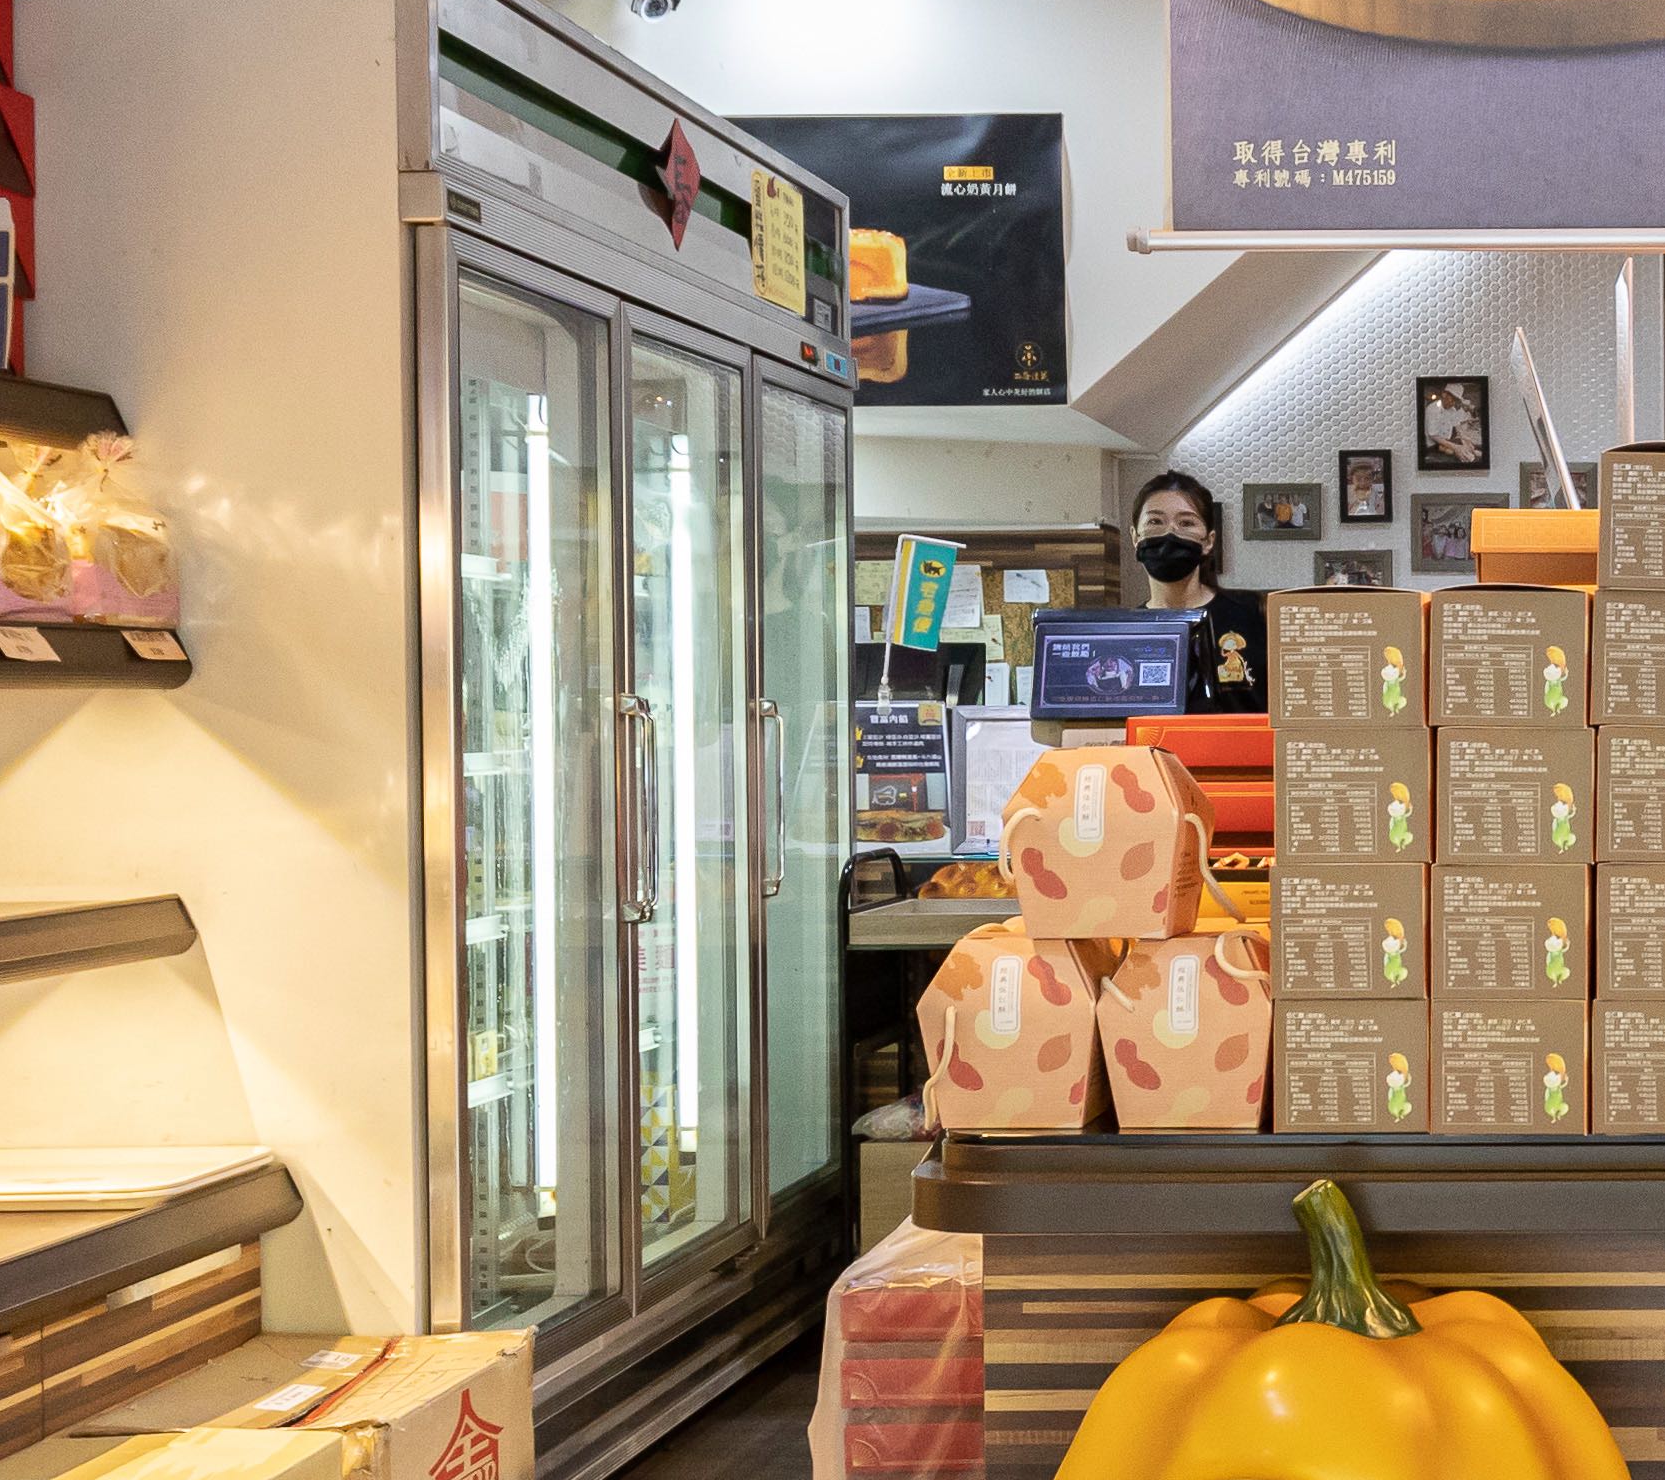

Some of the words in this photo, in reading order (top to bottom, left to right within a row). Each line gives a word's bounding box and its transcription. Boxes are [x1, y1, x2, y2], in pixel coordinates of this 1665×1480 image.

[1233, 140, 1397, 167] 取得台灣專利
